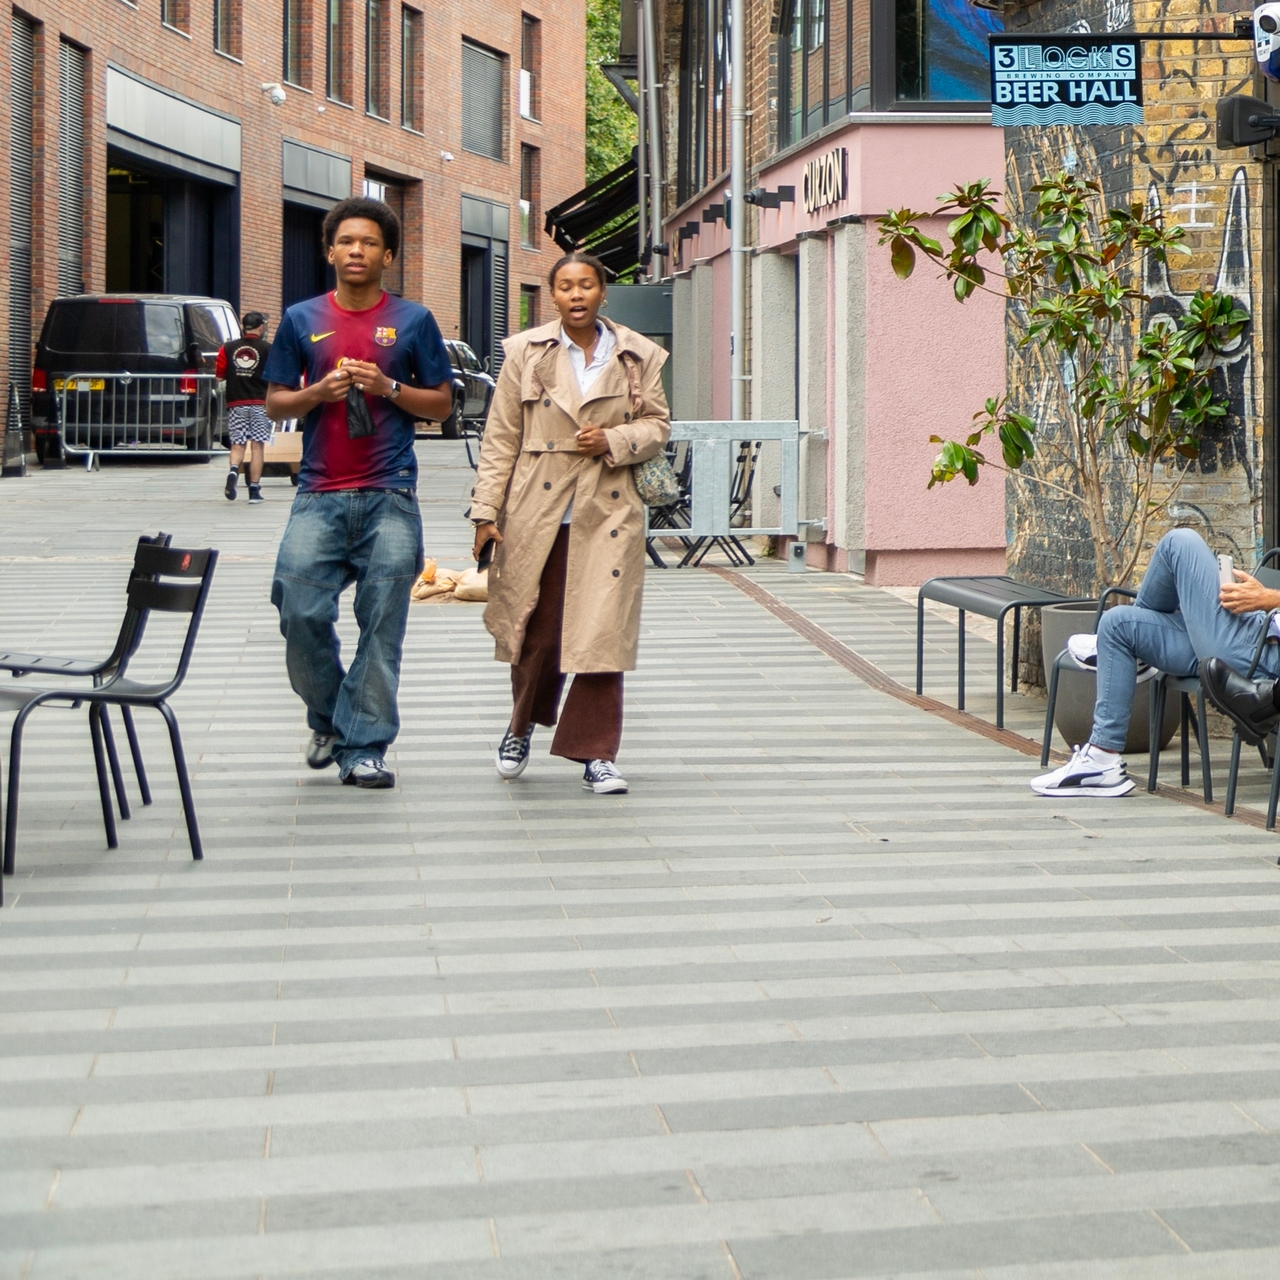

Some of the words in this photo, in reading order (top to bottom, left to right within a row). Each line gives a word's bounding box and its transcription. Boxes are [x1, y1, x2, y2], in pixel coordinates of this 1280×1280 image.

[995, 81, 1062, 103] BEER
[1069, 80, 1138, 102] HALL
[802, 147, 845, 214] CURZON
